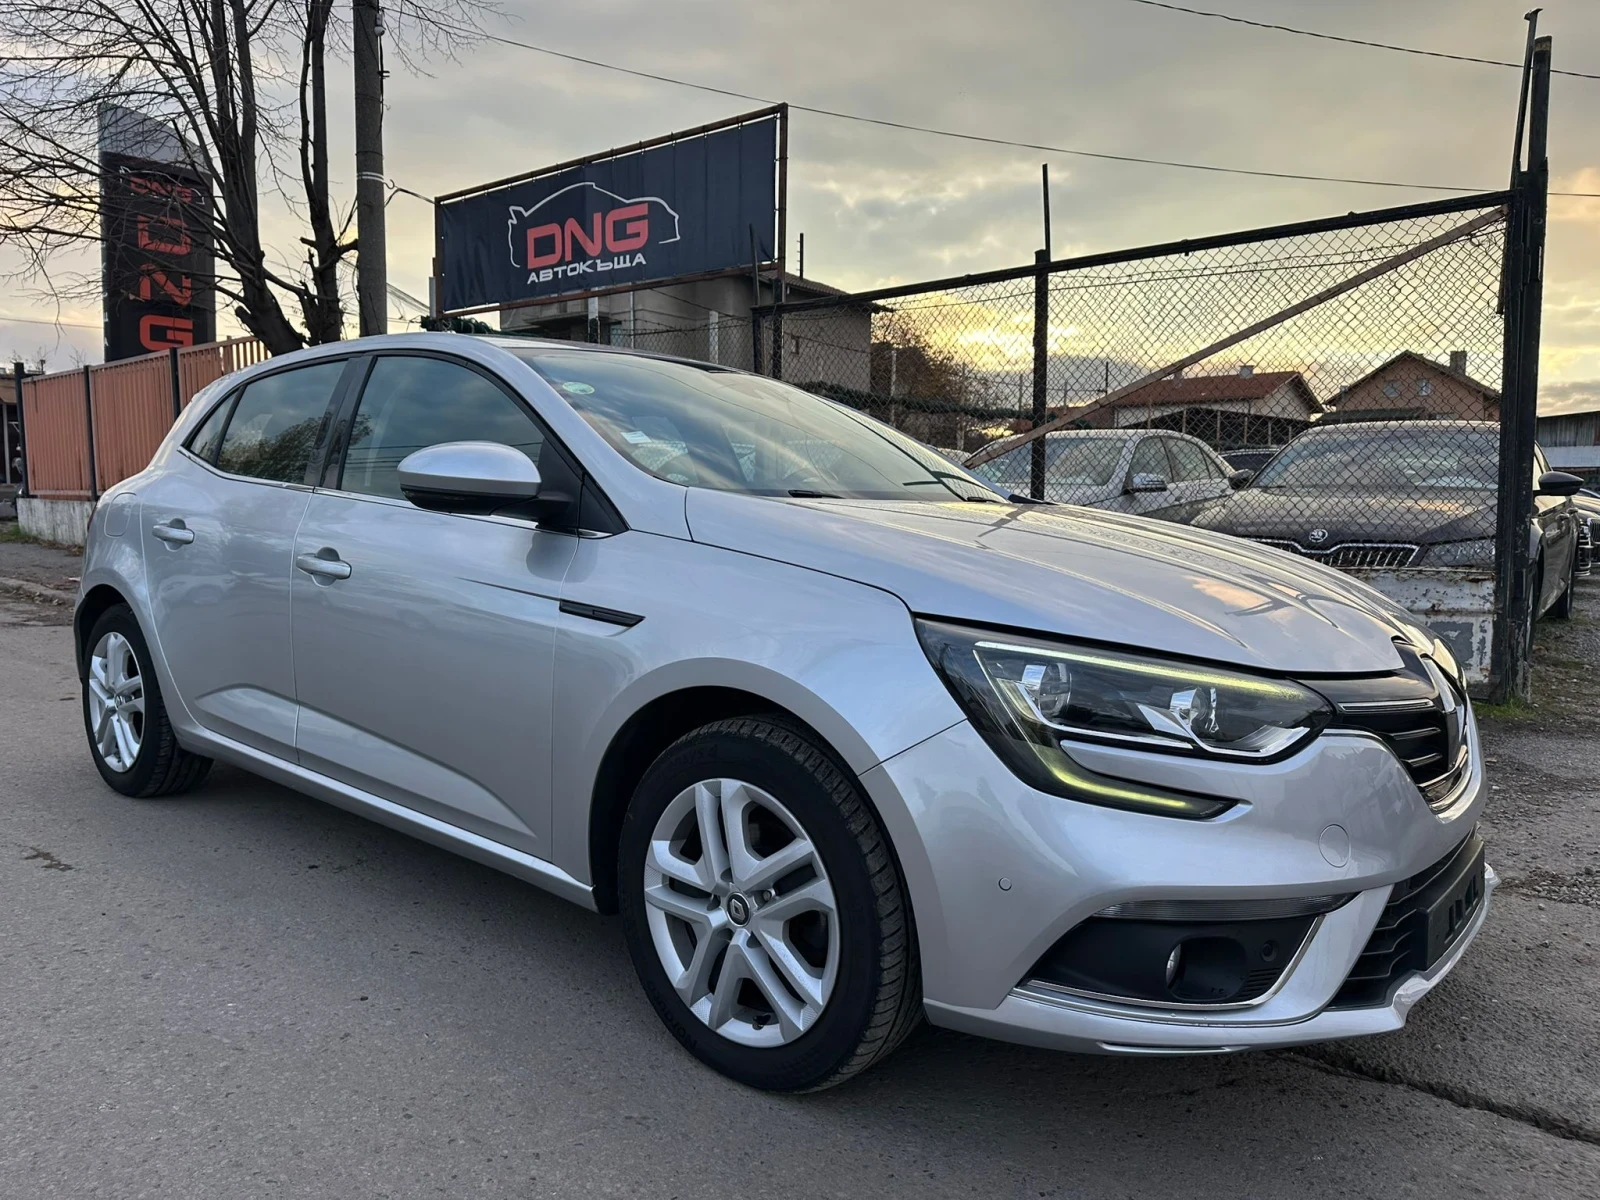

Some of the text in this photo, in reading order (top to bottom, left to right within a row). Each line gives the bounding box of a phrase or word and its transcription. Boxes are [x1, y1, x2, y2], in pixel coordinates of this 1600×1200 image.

[526, 202, 649, 270] DNG
[526, 252, 648, 285] АВТОКЪЩА
[137, 214, 194, 351] DNG
